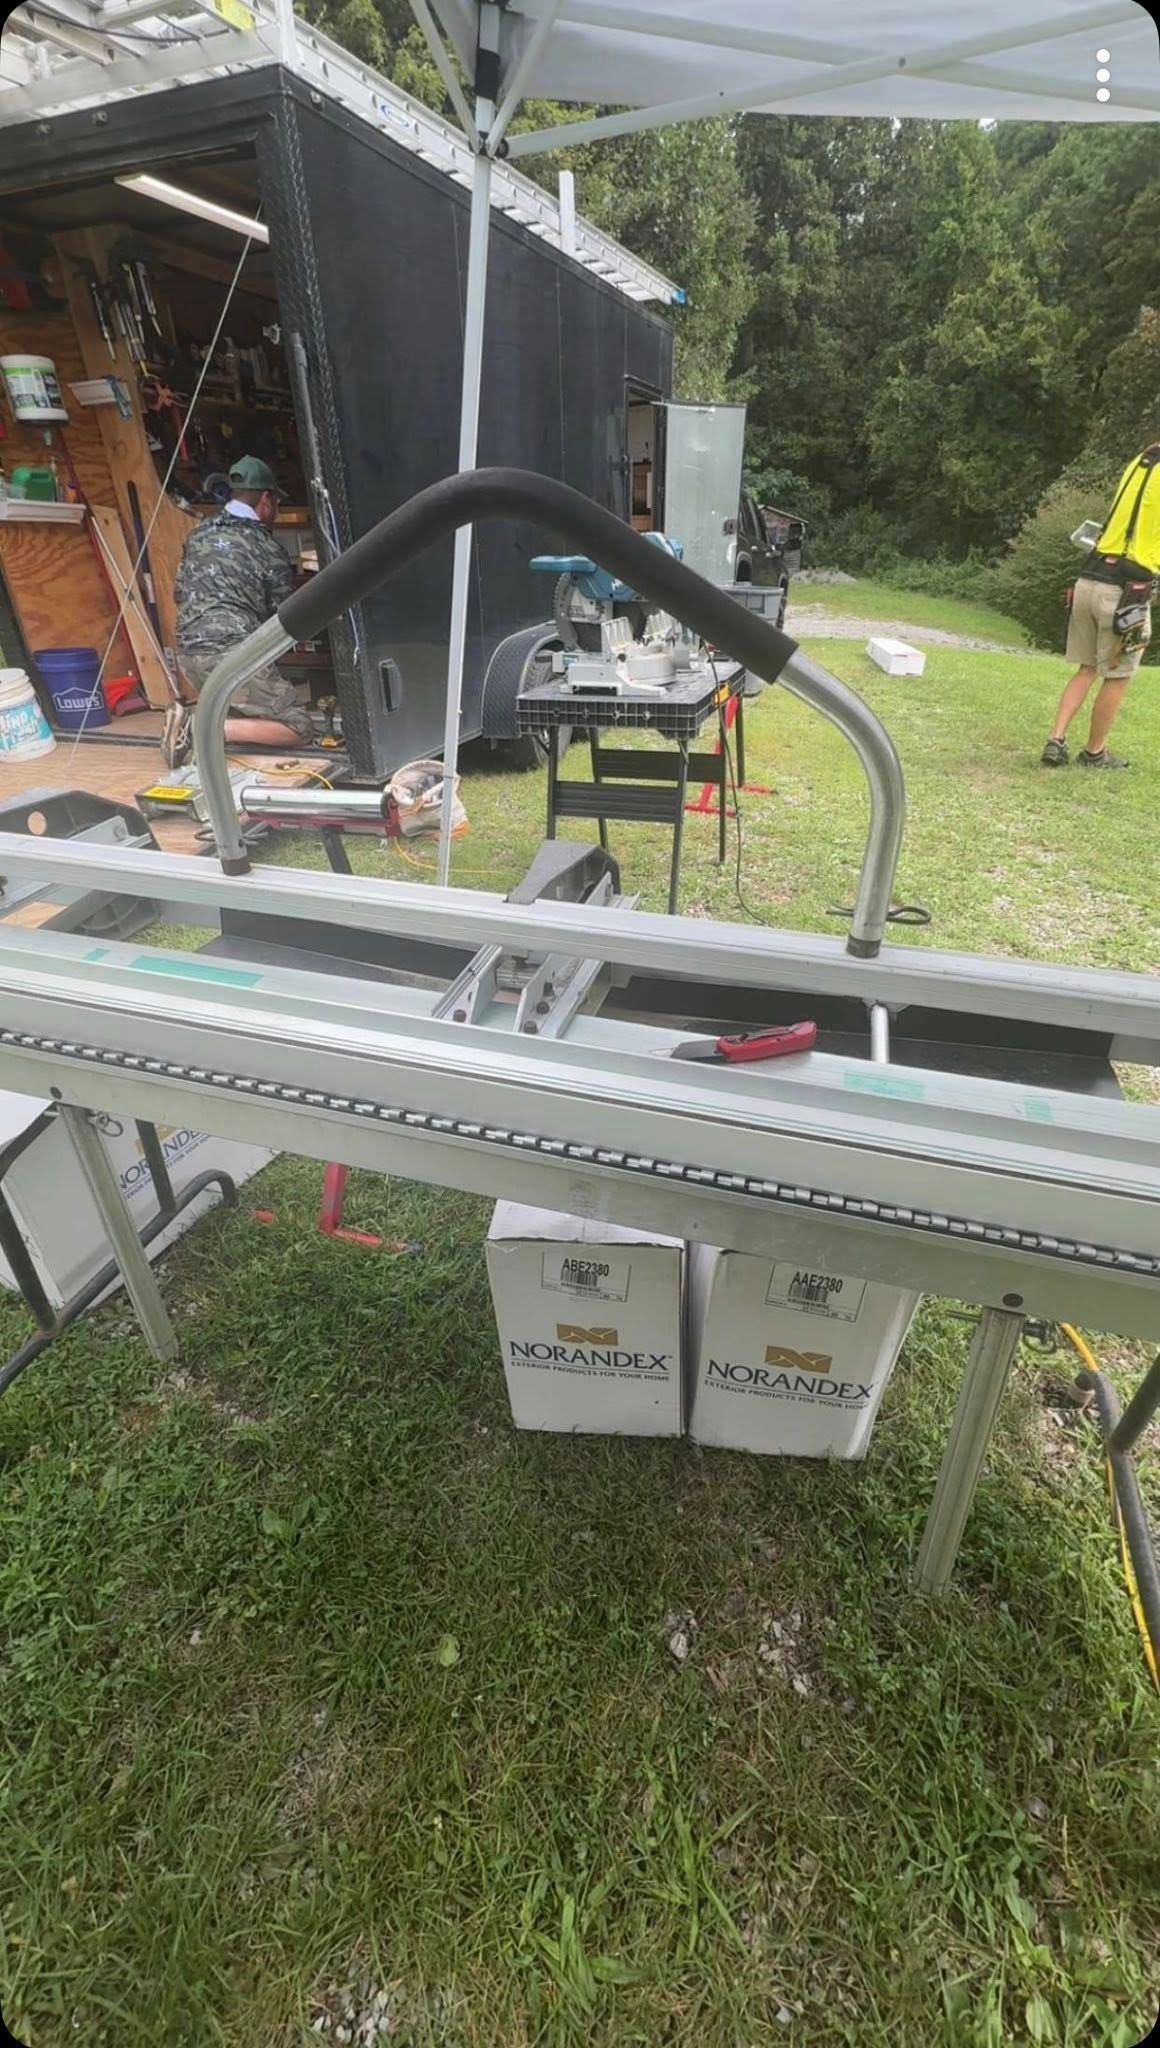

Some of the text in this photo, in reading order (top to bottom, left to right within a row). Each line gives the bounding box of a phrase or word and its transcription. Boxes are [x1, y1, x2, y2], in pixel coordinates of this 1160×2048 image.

[562, 1258, 610, 1277] ABE2380
[792, 1272, 843, 1293] AAE2380
[509, 1341, 669, 1371] NORANDEX
[511, 1361, 550, 1371] EXTERIOR
[553, 1366, 598, 1377] PRODUCTS
[600, 1371, 617, 1379] FOR
[644, 1374, 670, 1382] HOME
[707, 1359, 874, 1400] NORANDEX
[704, 1379, 746, 1395] EXTERIOR
[748, 1390, 796, 1402] PRODUCTS
[799, 1396, 815, 1404] FOR
